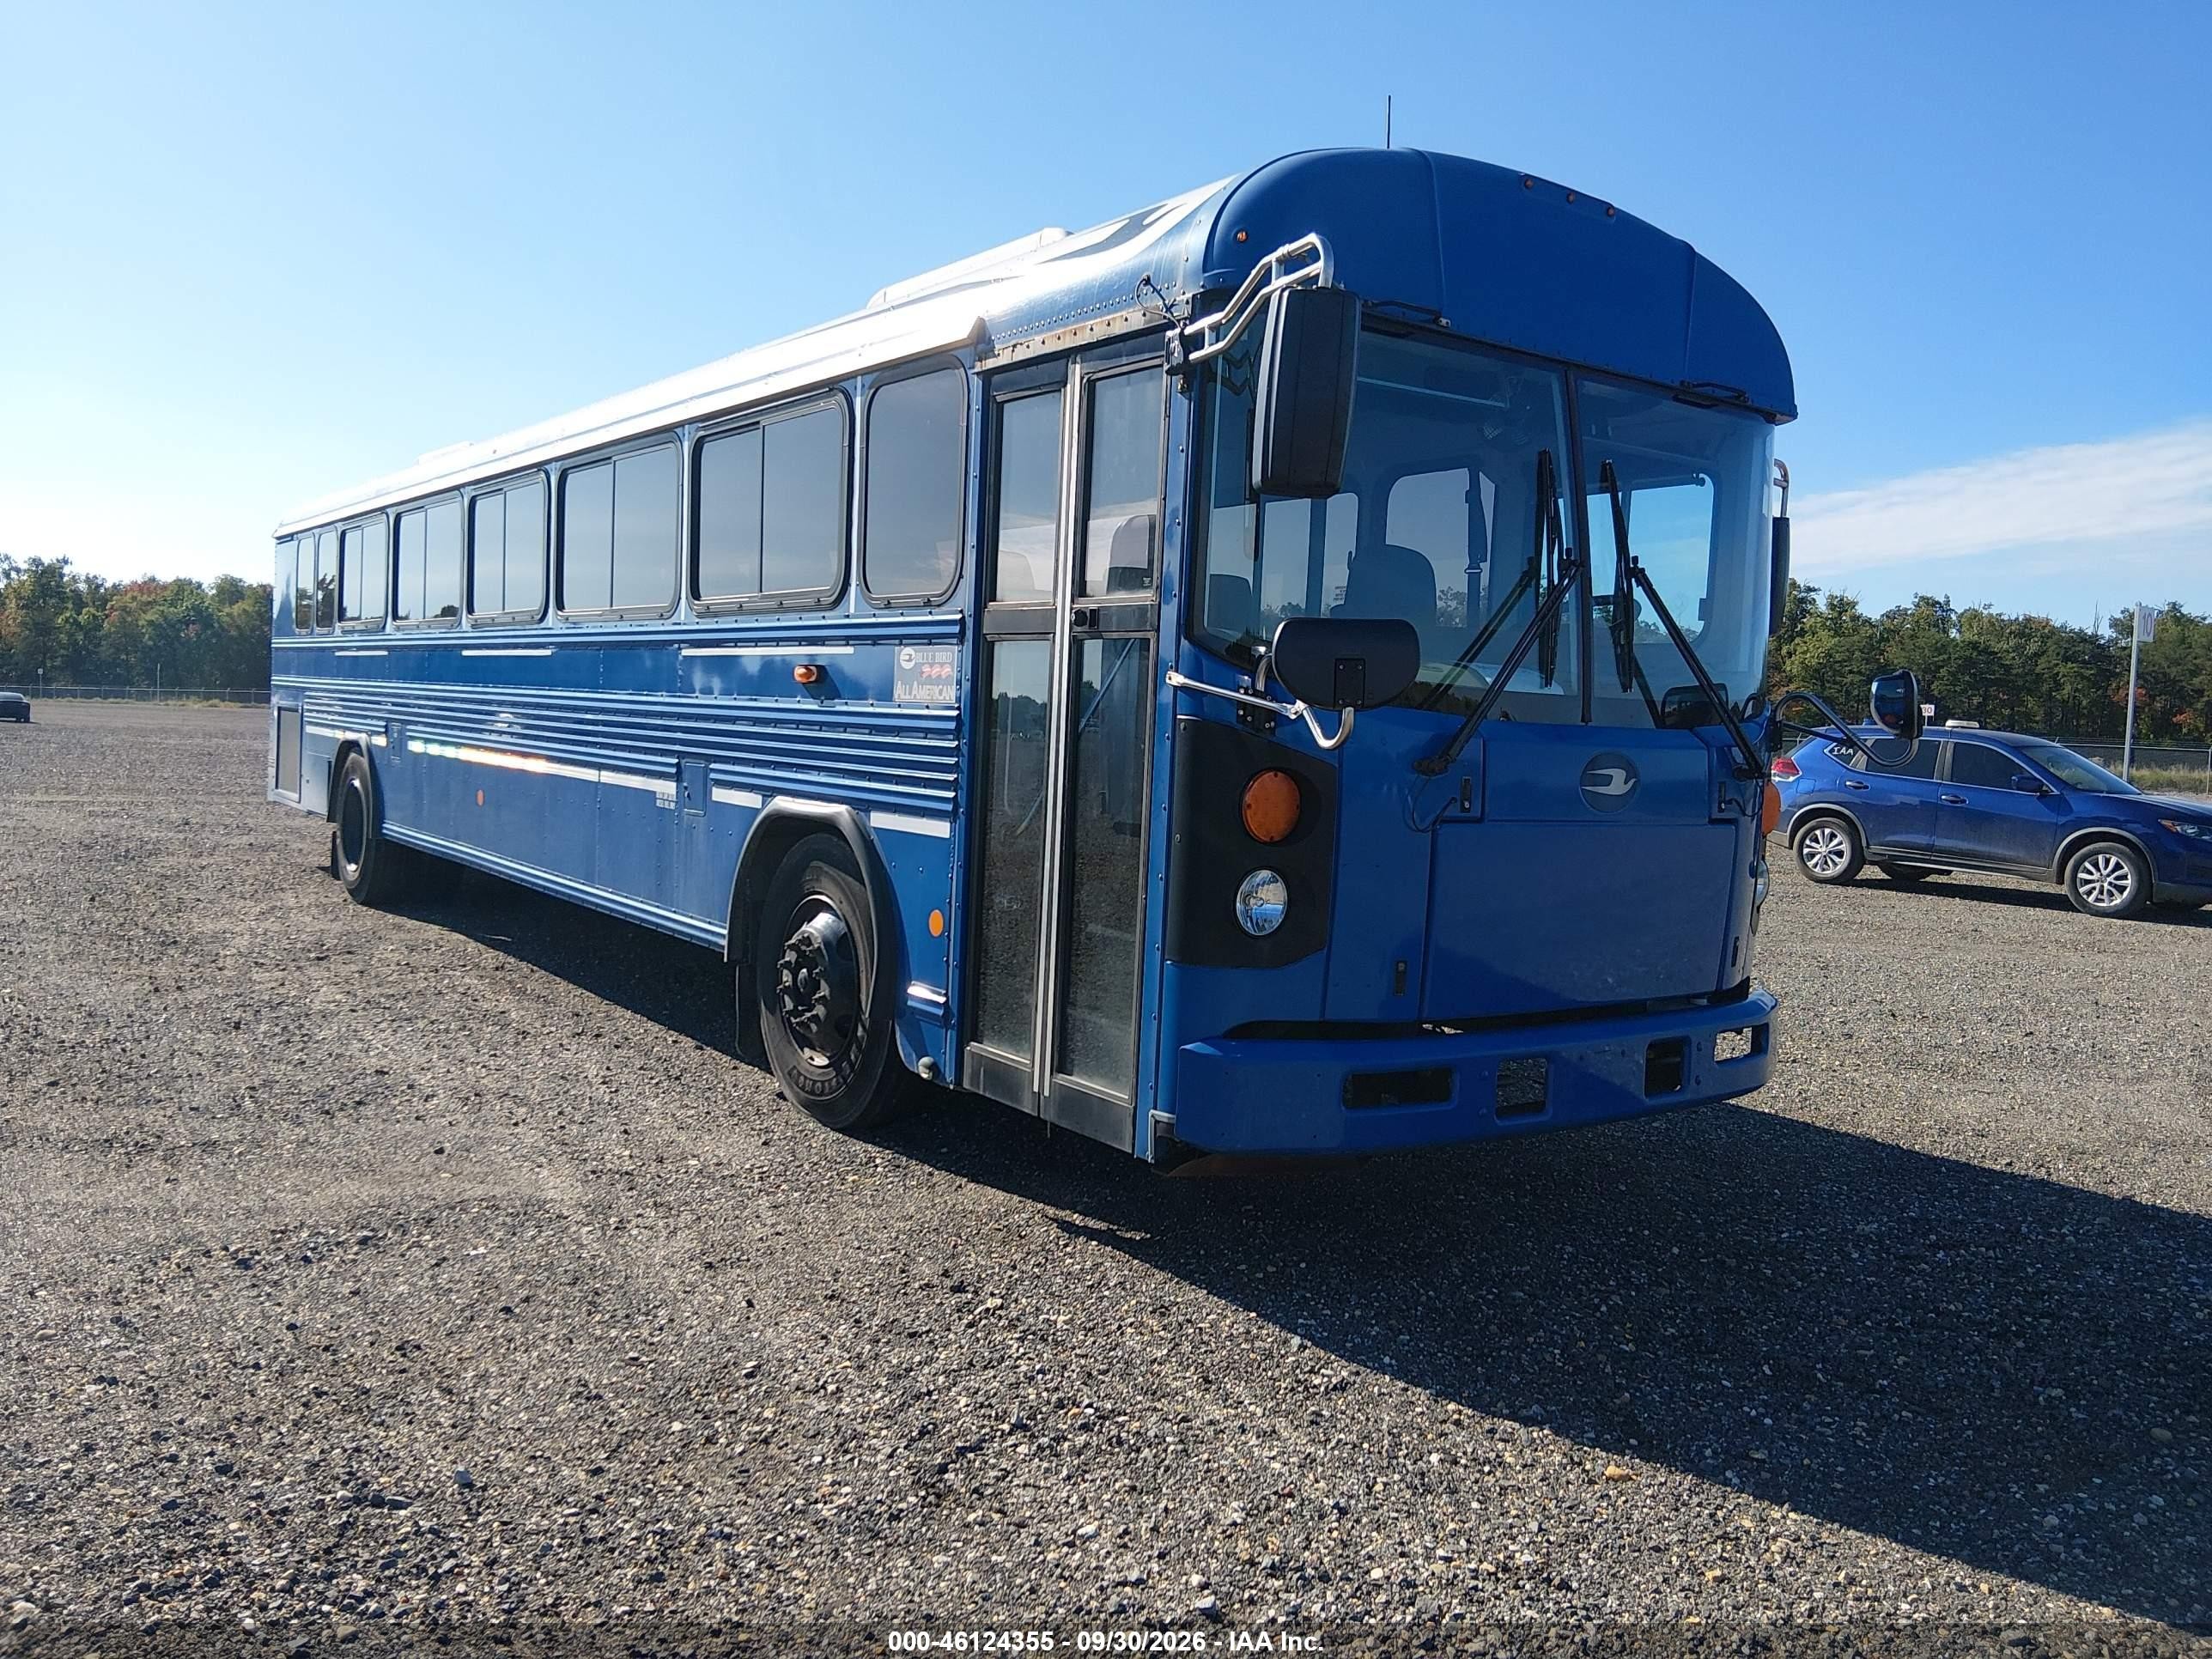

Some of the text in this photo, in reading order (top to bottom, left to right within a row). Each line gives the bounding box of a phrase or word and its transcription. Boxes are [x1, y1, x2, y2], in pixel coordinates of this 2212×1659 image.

[2142, 611, 2153, 637] 10
[915, 652, 952, 663] BLUE BIRD
[1832, 746, 1854, 756] IAA
